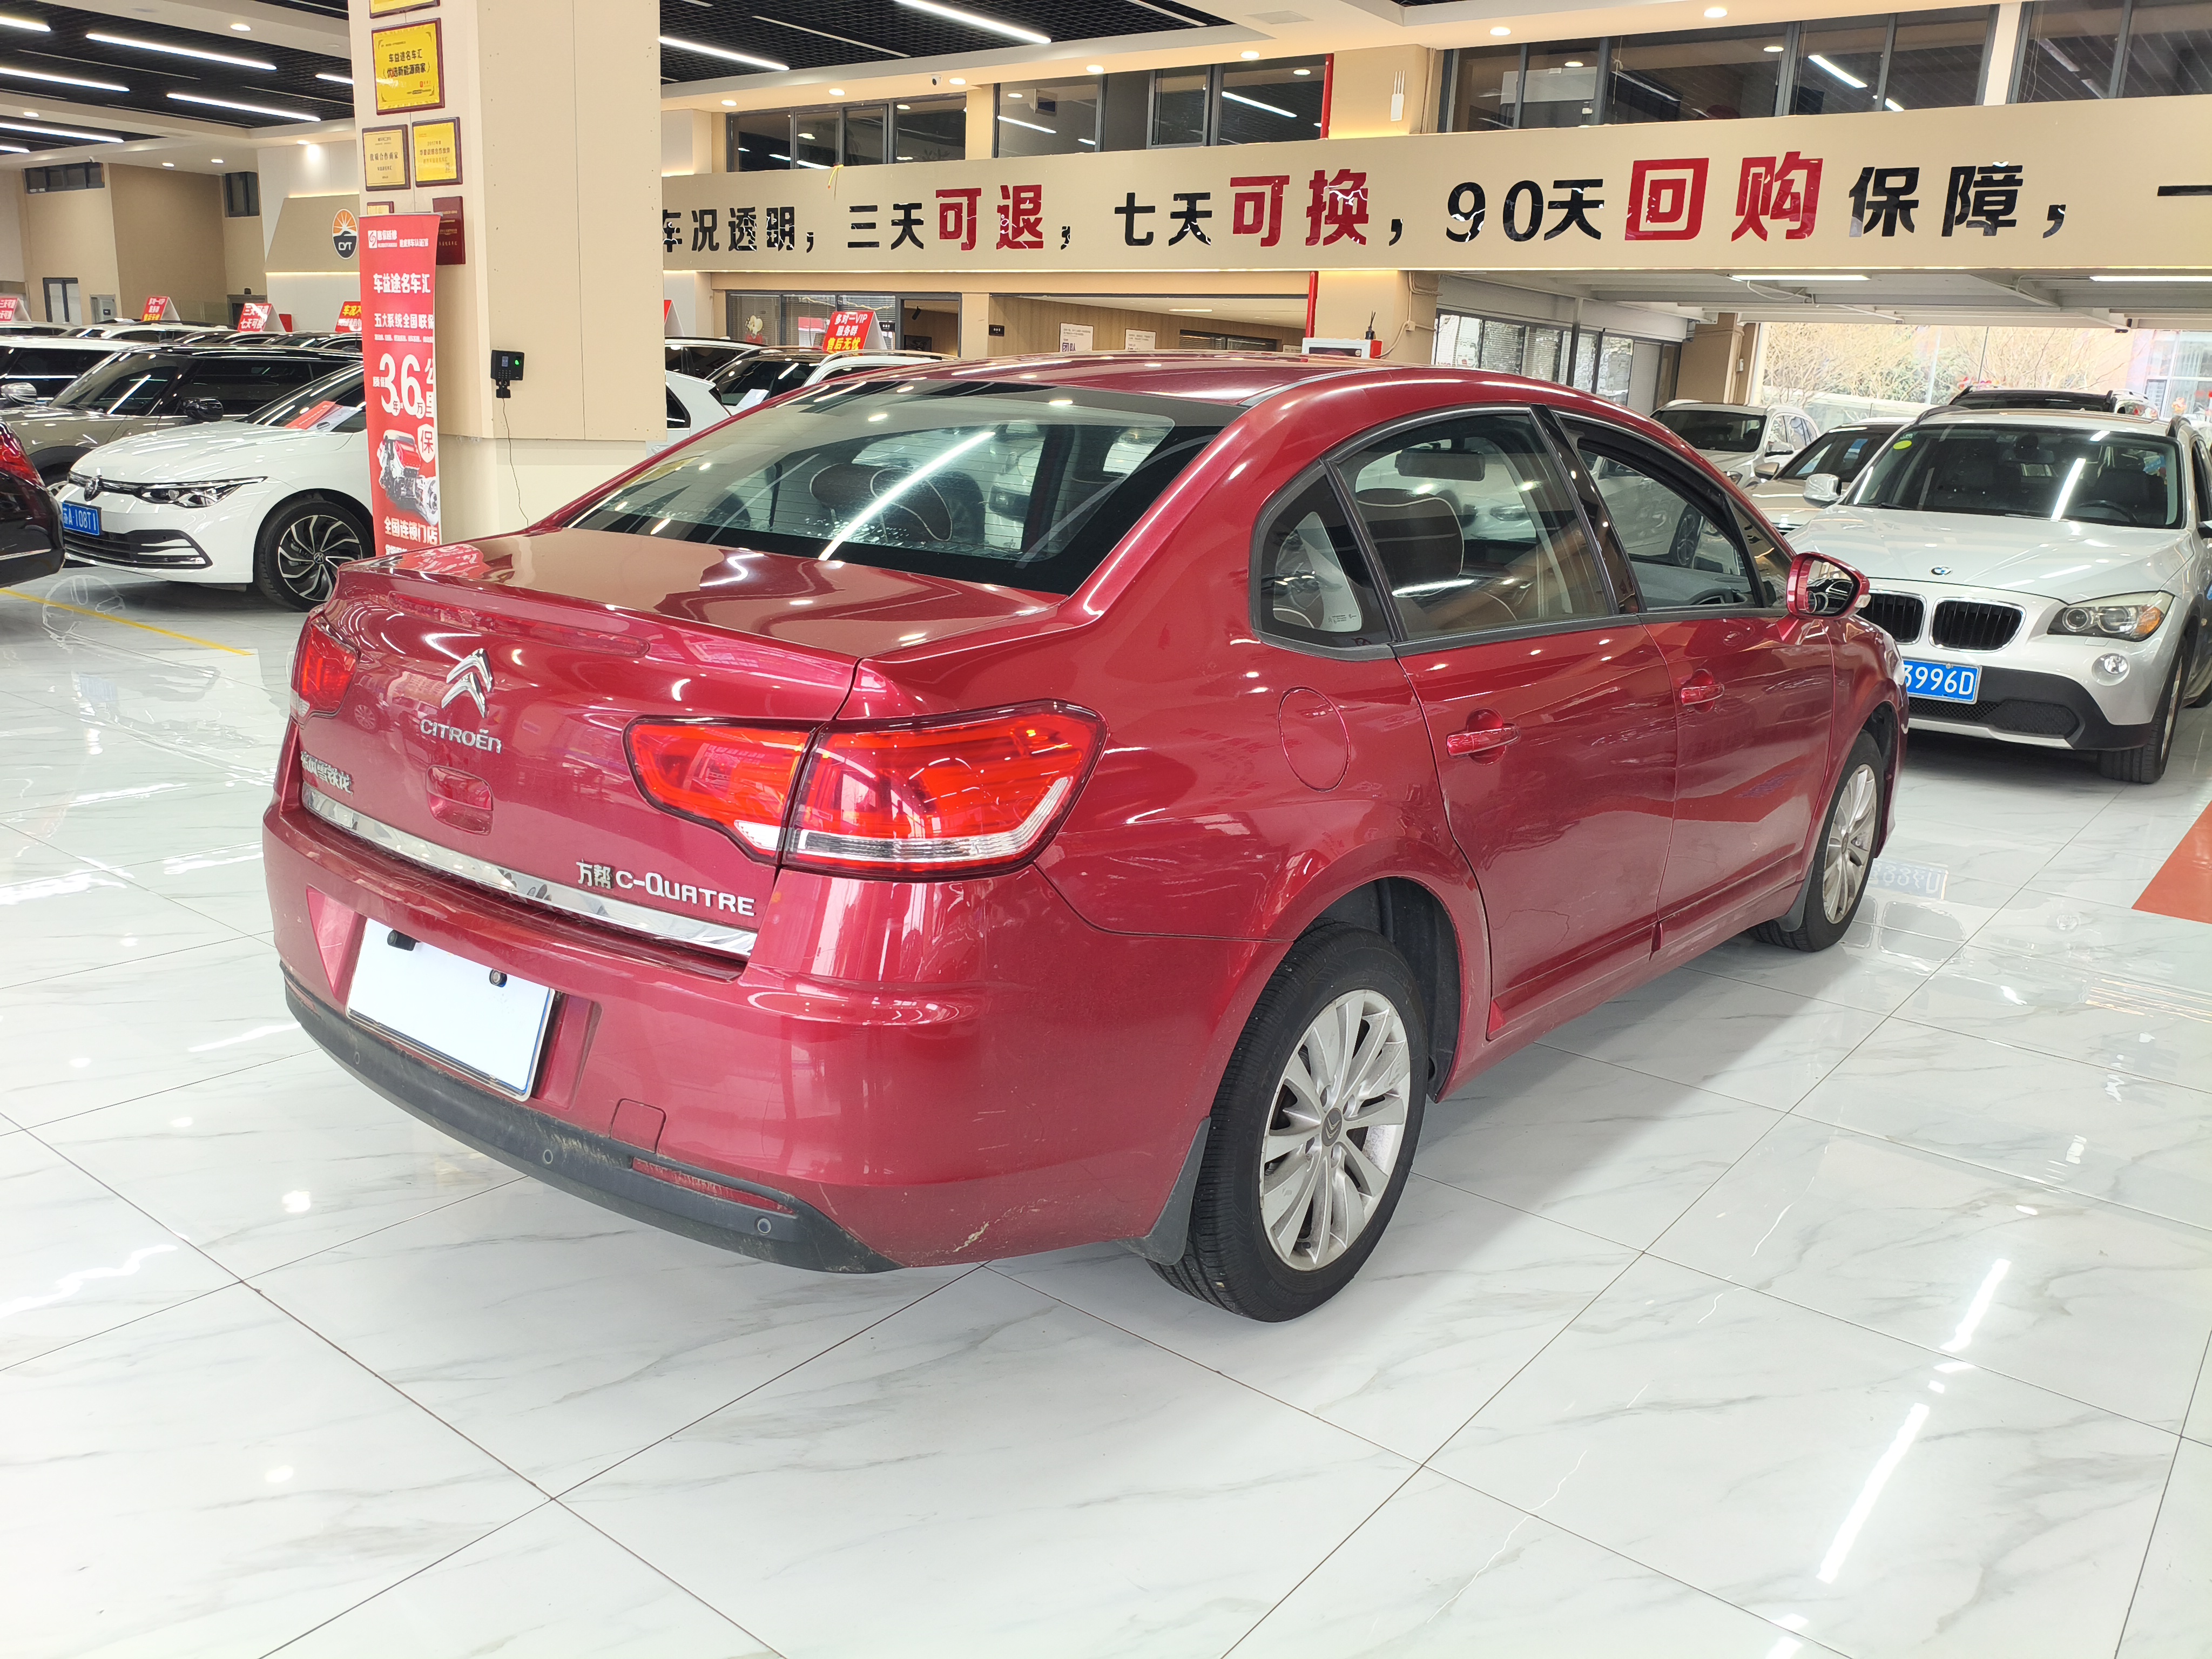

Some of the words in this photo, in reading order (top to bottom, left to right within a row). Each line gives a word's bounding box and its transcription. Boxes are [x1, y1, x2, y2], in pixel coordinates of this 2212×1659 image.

[373, 273, 431, 293] 车益途名车汇
[384, 516, 438, 545] 全国连锁门店
[420, 719, 502, 754] CITROËN
[616, 871, 755, 916] C-QUATRE
